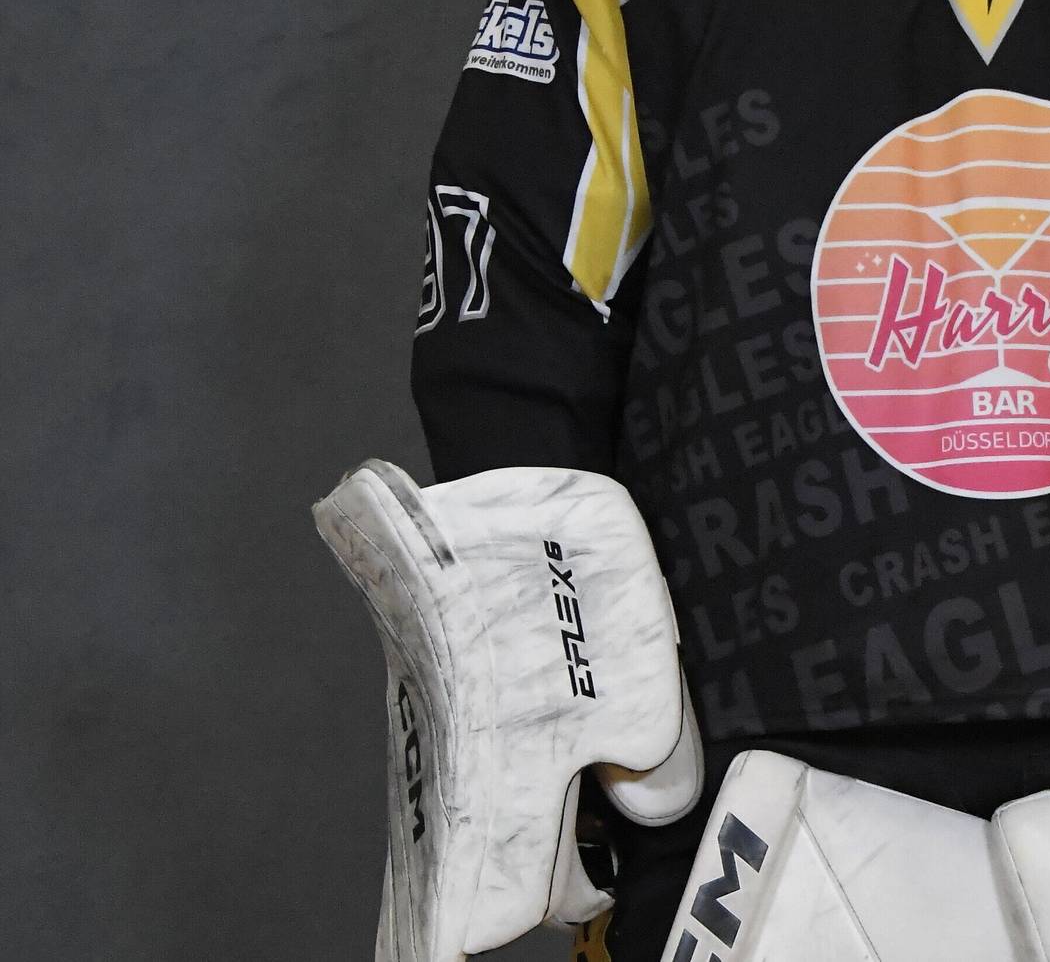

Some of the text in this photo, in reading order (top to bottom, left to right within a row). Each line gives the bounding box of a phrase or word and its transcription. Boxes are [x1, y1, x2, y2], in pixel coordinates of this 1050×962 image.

[972, 390, 1038, 417] BAR
[839, 515, 1010, 607] CRASH
[547, 561, 596, 700] EFLEX
[397, 680, 426, 845] CCM
